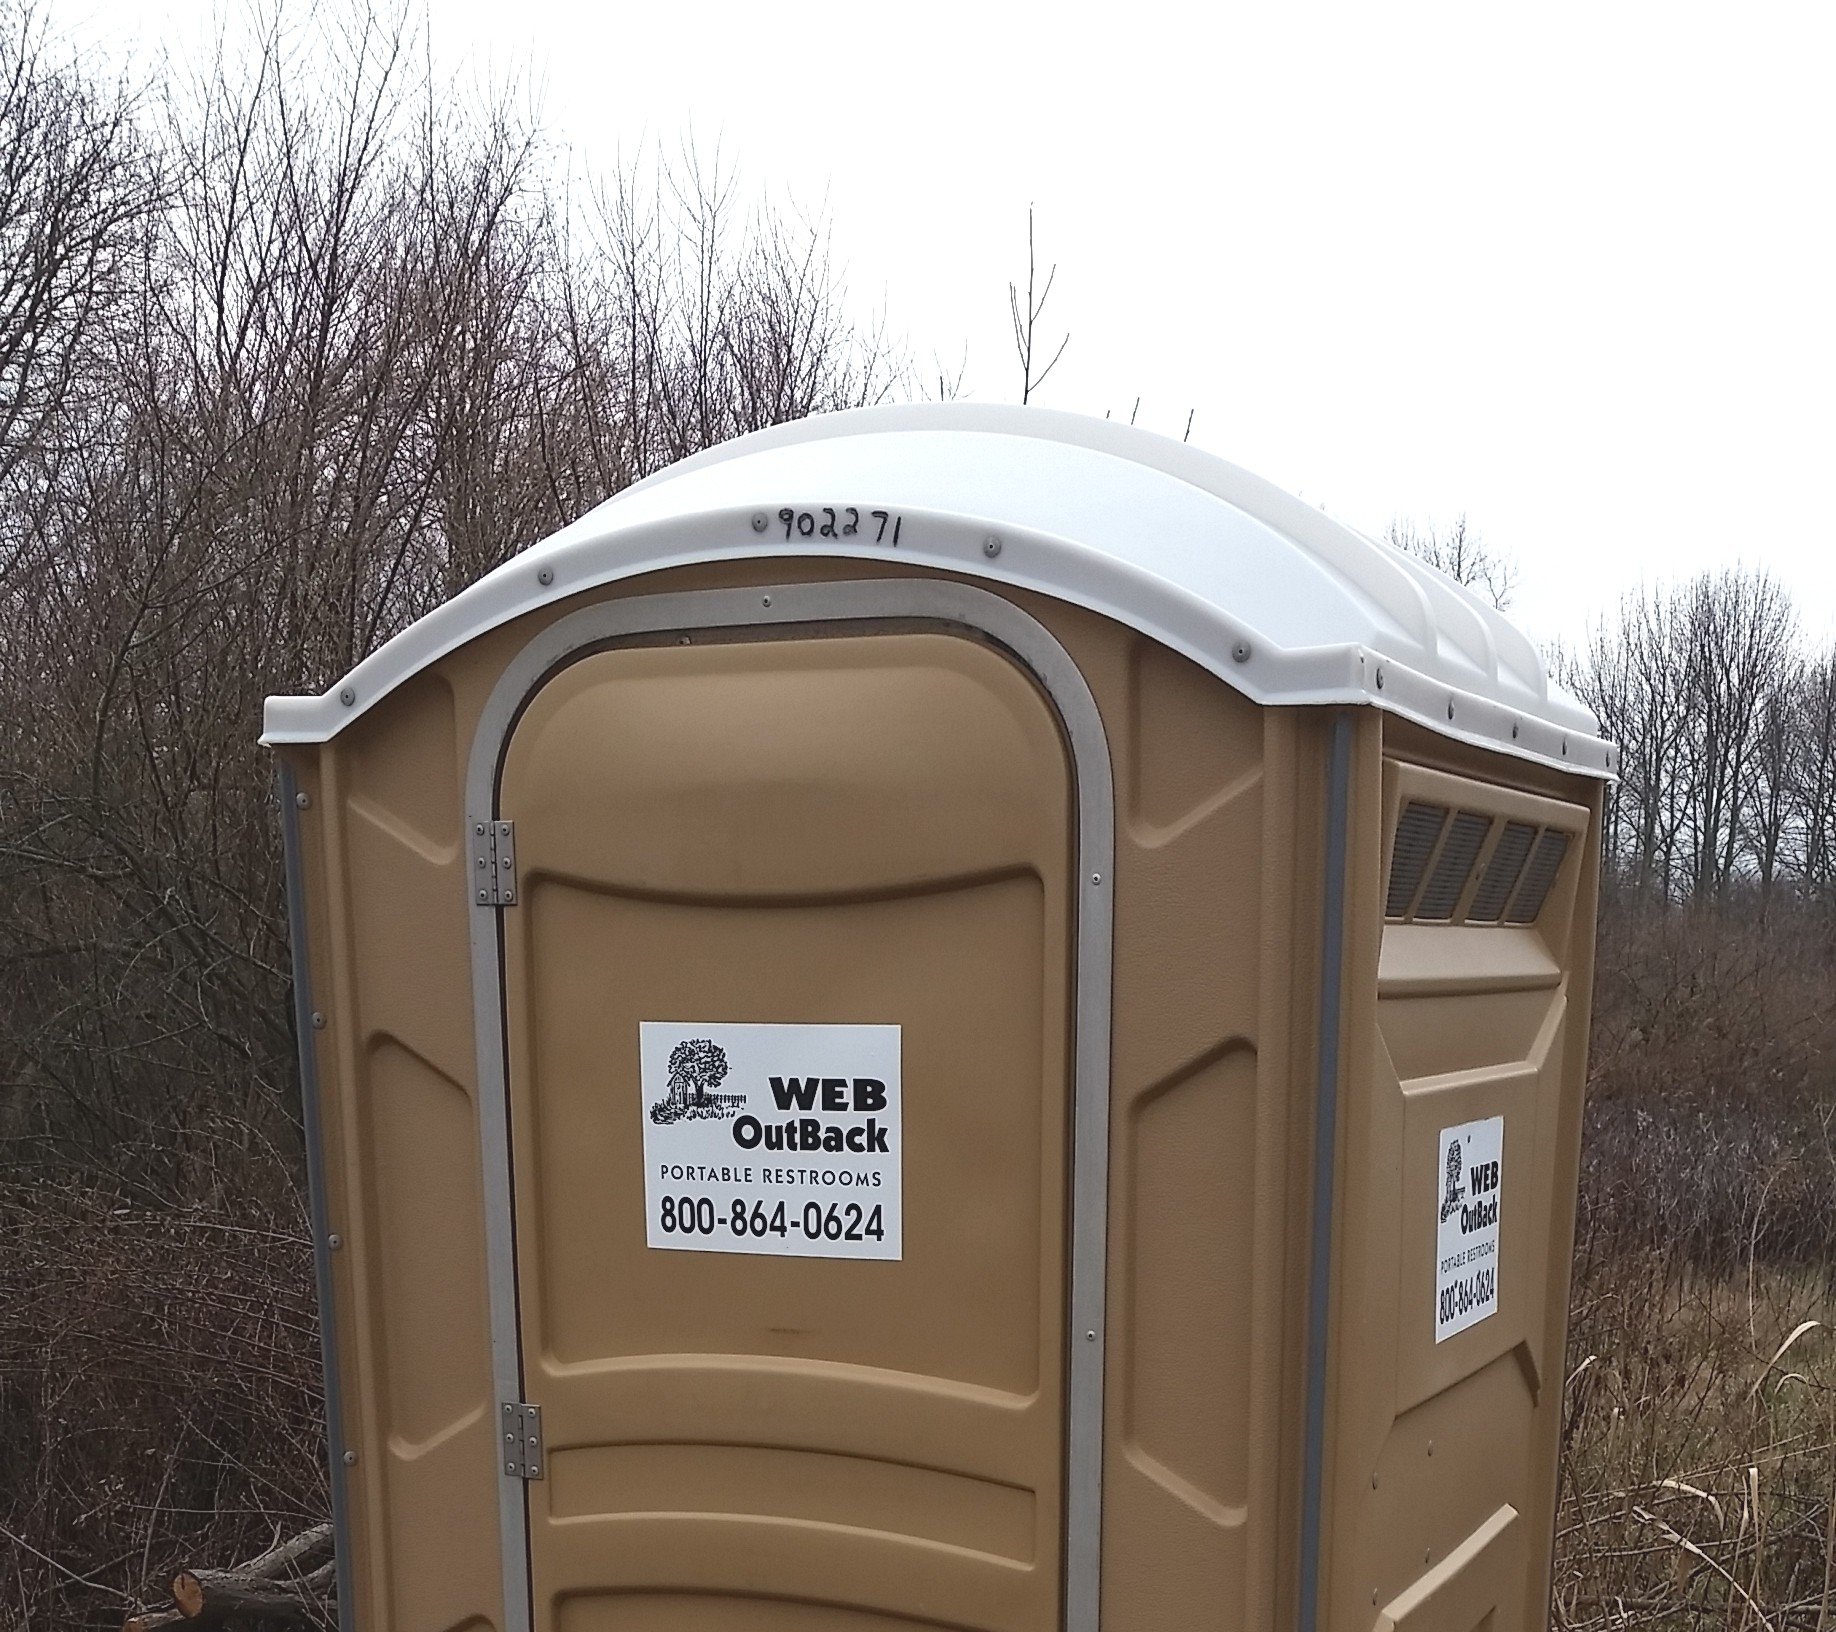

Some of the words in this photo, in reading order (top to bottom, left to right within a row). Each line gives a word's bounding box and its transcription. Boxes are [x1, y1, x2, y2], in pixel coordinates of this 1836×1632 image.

[768, 1076, 888, 1112] WEB
[732, 1114, 890, 1153] OutBack
[660, 1164, 753, 1183] PORTABLE
[762, 1168, 882, 1187] RESTROOMS
[1470, 1161, 1498, 1196] WEB
[660, 1195, 885, 1242] 800-864-0624
[1460, 1194, 1497, 1235] OutBack
[1440, 1252, 1466, 1274] PORTABLE
[1467, 1240, 1495, 1263] RESTROOMS
[1439, 1268, 1495, 1324] 800-864-0624
